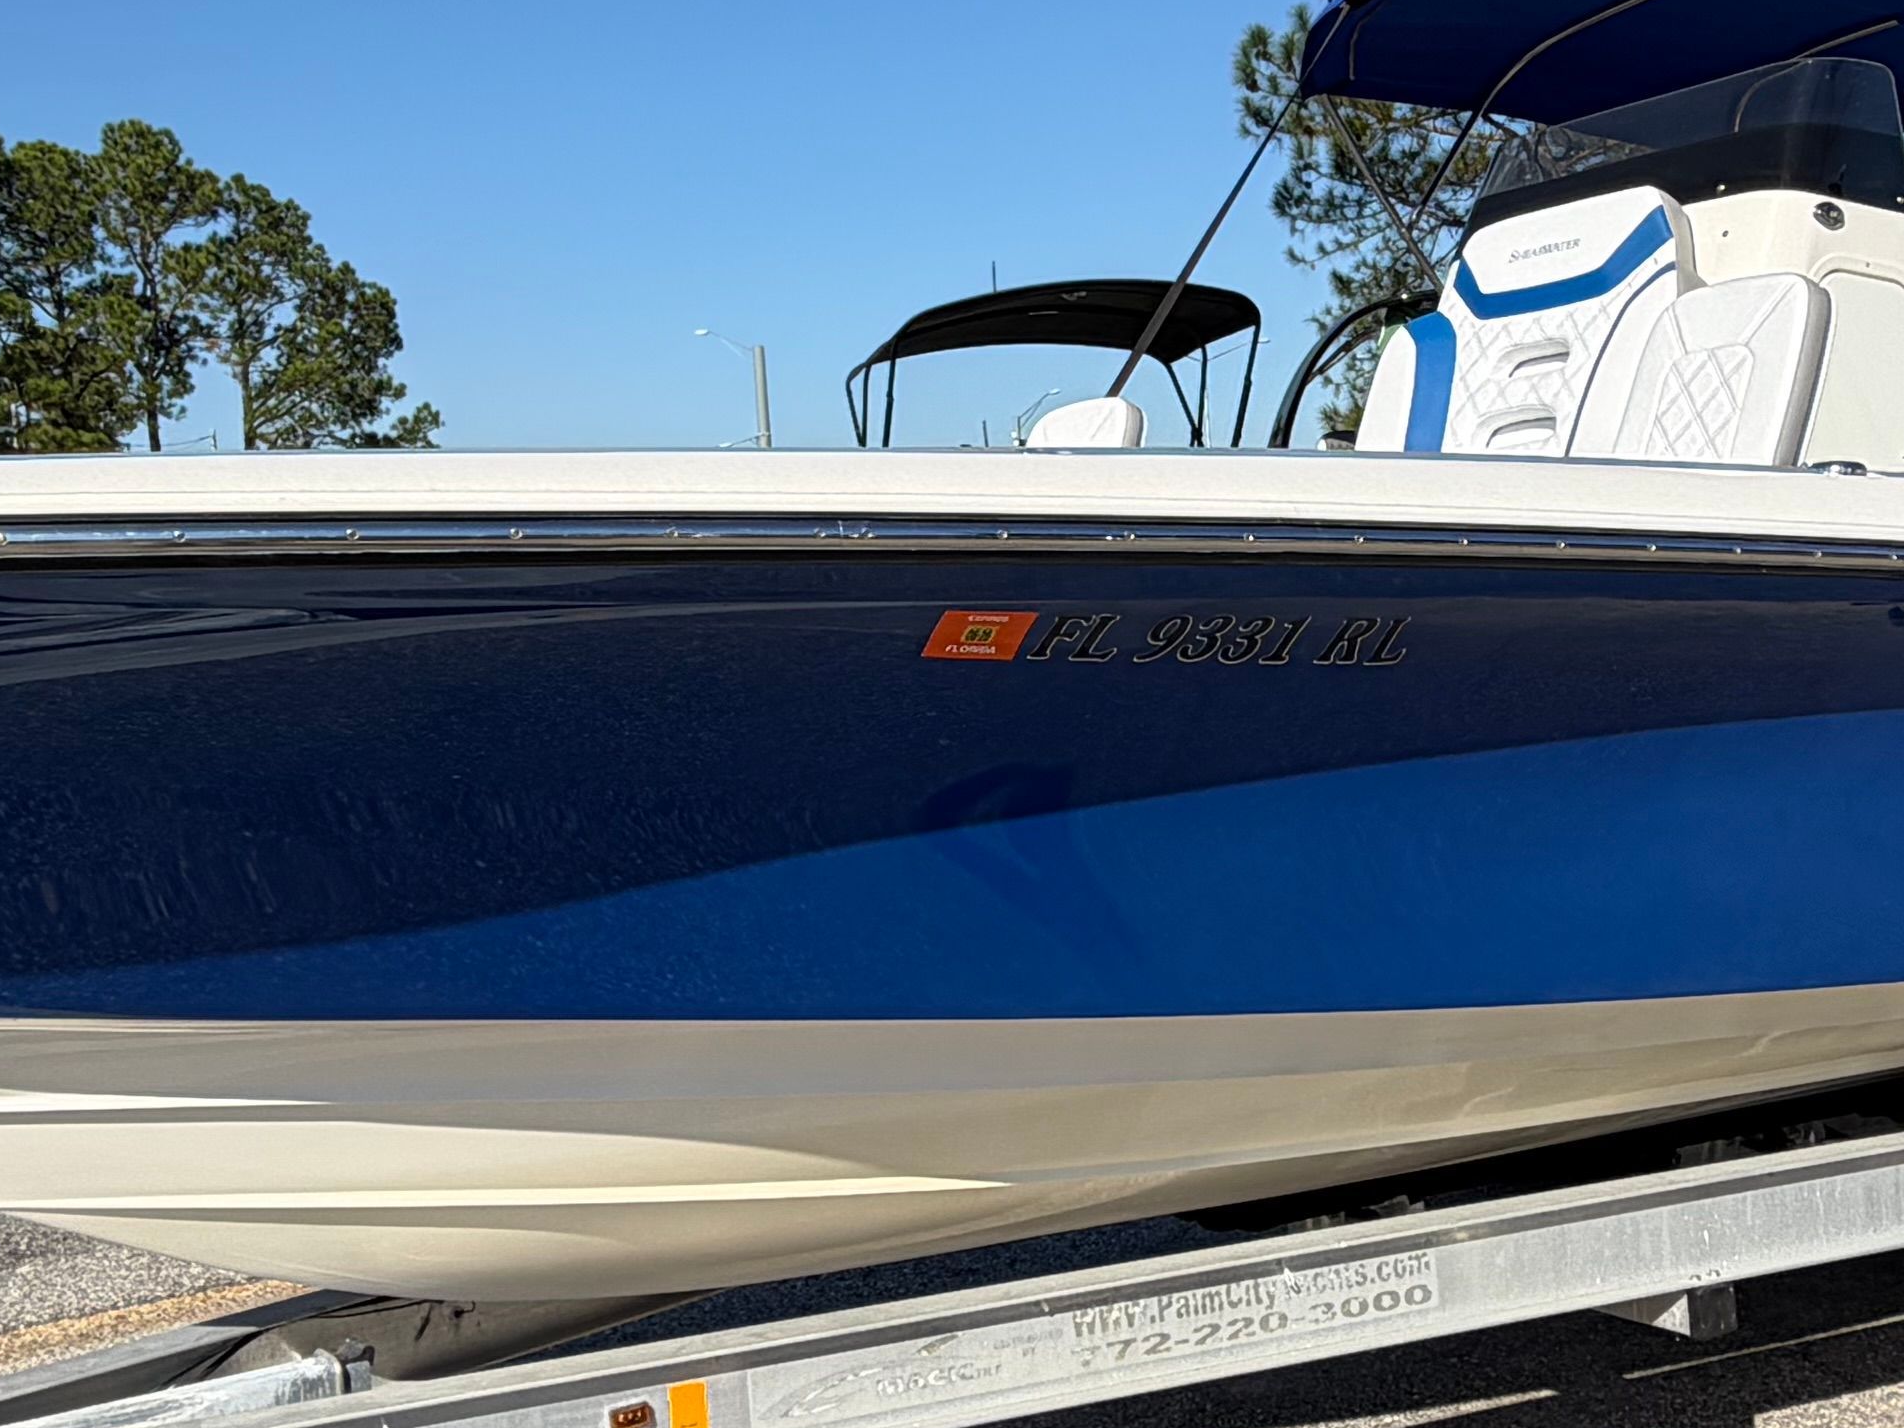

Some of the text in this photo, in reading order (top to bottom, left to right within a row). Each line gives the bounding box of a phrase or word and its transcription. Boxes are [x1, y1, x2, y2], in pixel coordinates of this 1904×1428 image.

[1026, 612, 1412, 667] FL 9331 RL
